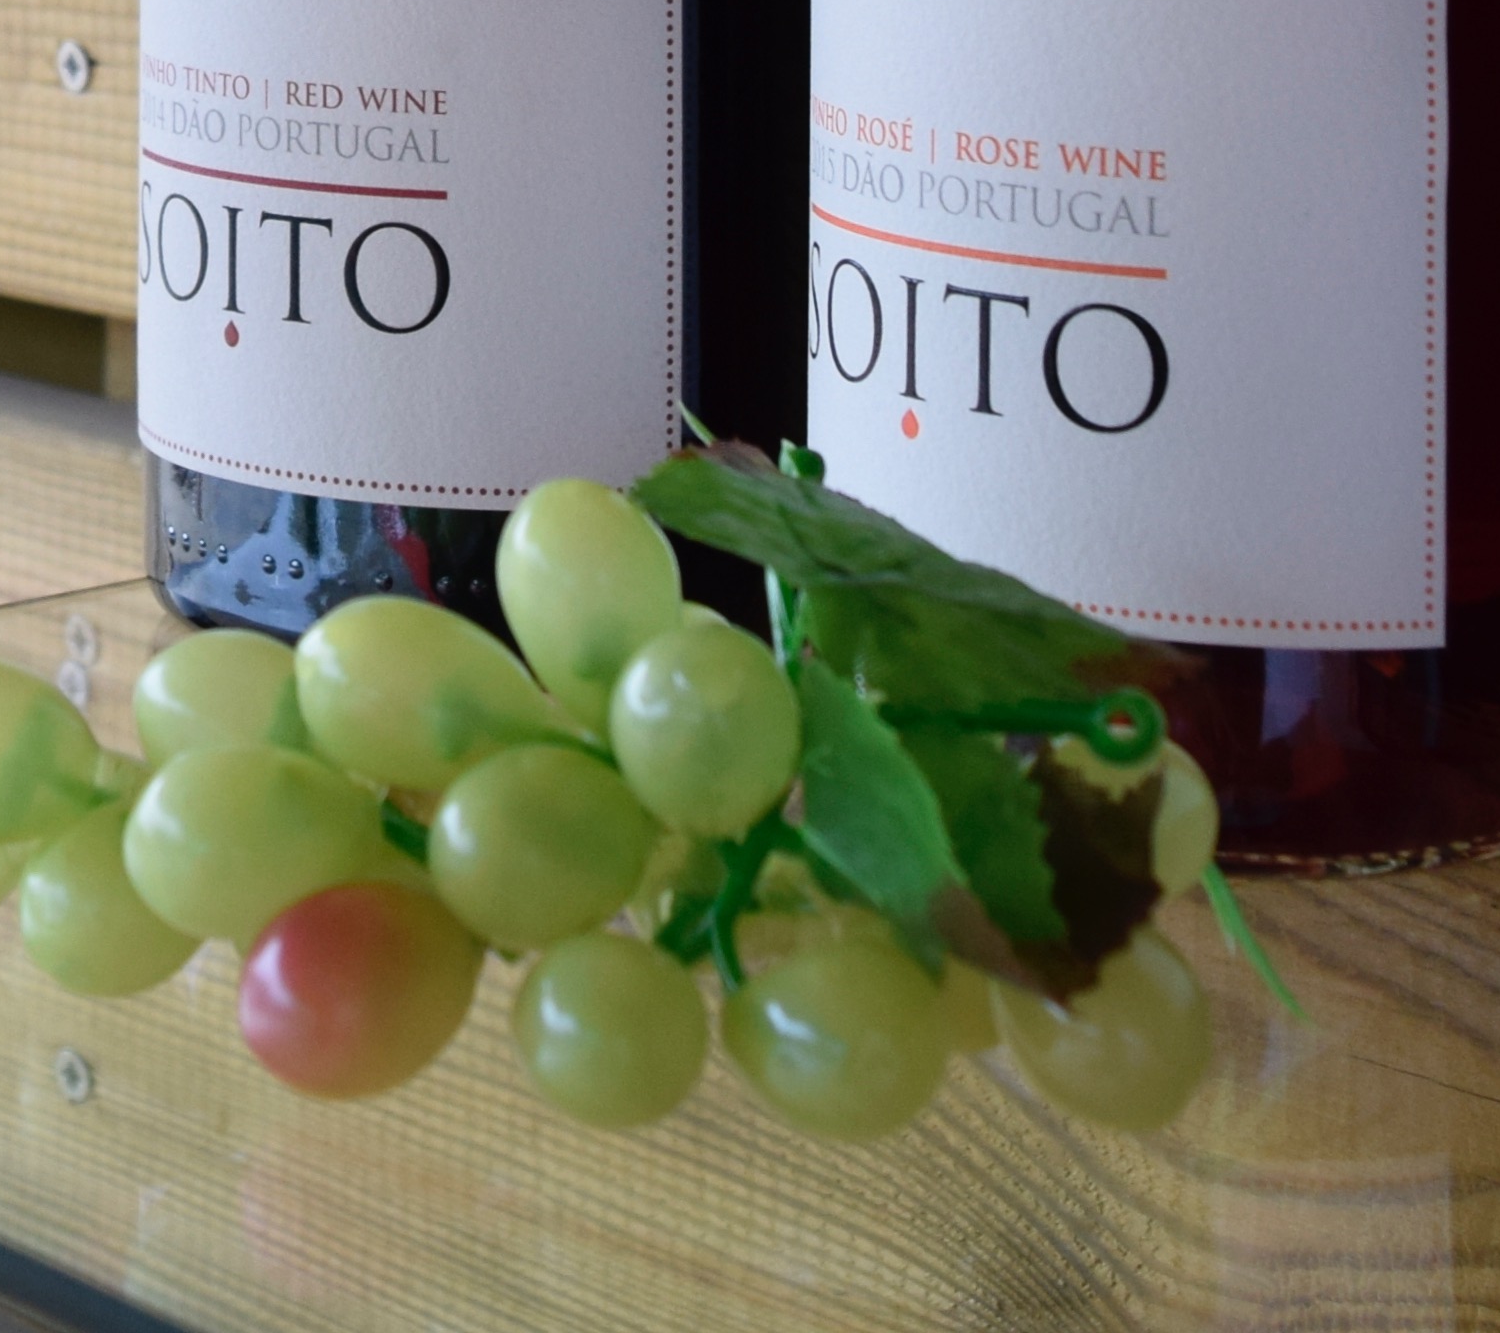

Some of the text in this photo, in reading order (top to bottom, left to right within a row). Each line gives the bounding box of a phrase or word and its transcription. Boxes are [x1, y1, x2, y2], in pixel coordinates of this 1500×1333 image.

[182, 66, 251, 101] TINTO
[285, 81, 344, 110] RED
[356, 85, 448, 116] WINE
[171, 97, 226, 144] DÃO
[238, 112, 450, 165] PORTUGAL
[856, 113, 914, 153] ROSÉ
[955, 131, 1040, 170] ROSE
[1058, 143, 1168, 182] WINE
[842, 150, 905, 204] DÃO
[917, 170, 1171, 238] PORTUGAL
[140, 180, 451, 335] SOITO
[809, 240, 1170, 434] SOITO
